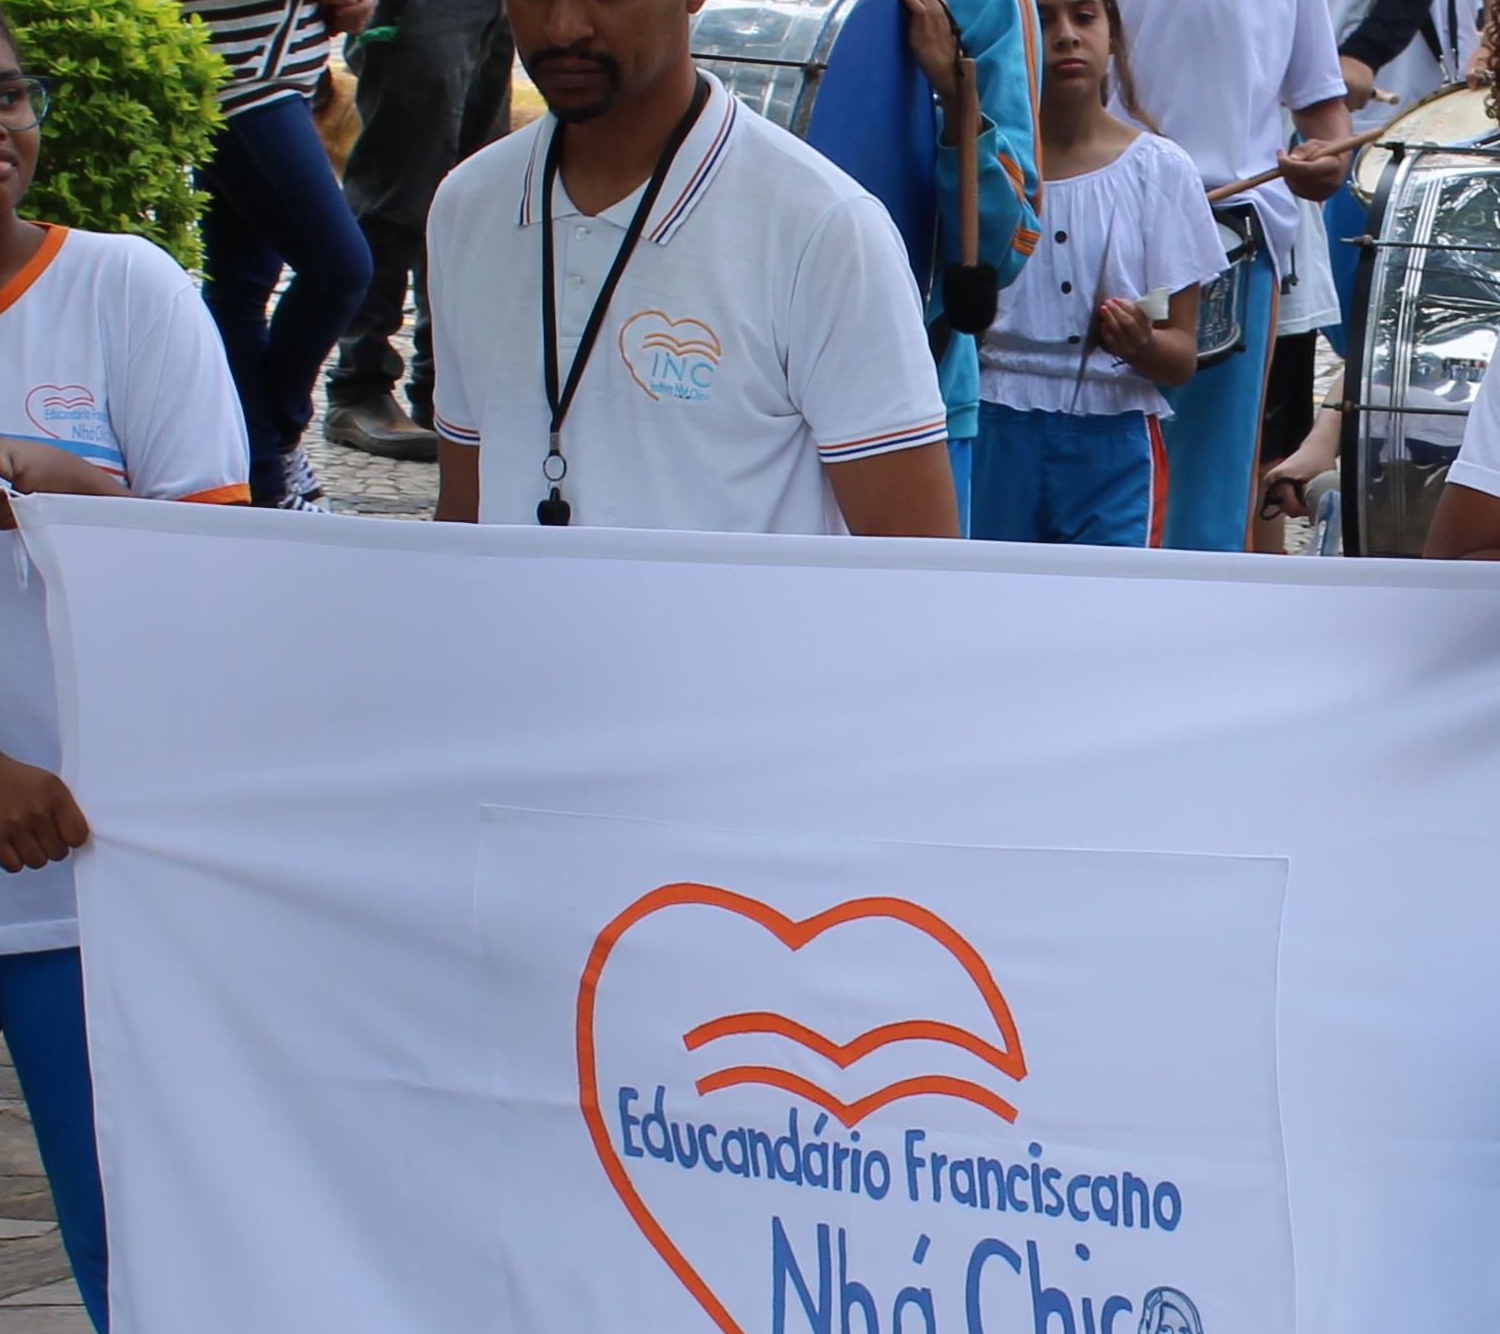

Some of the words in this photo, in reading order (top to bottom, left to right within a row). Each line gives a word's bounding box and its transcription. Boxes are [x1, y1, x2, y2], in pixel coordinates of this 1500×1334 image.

[651, 351, 715, 388] INC
[618, 1084, 891, 1201] Educandário
[904, 1129, 1182, 1233] Franciscano
